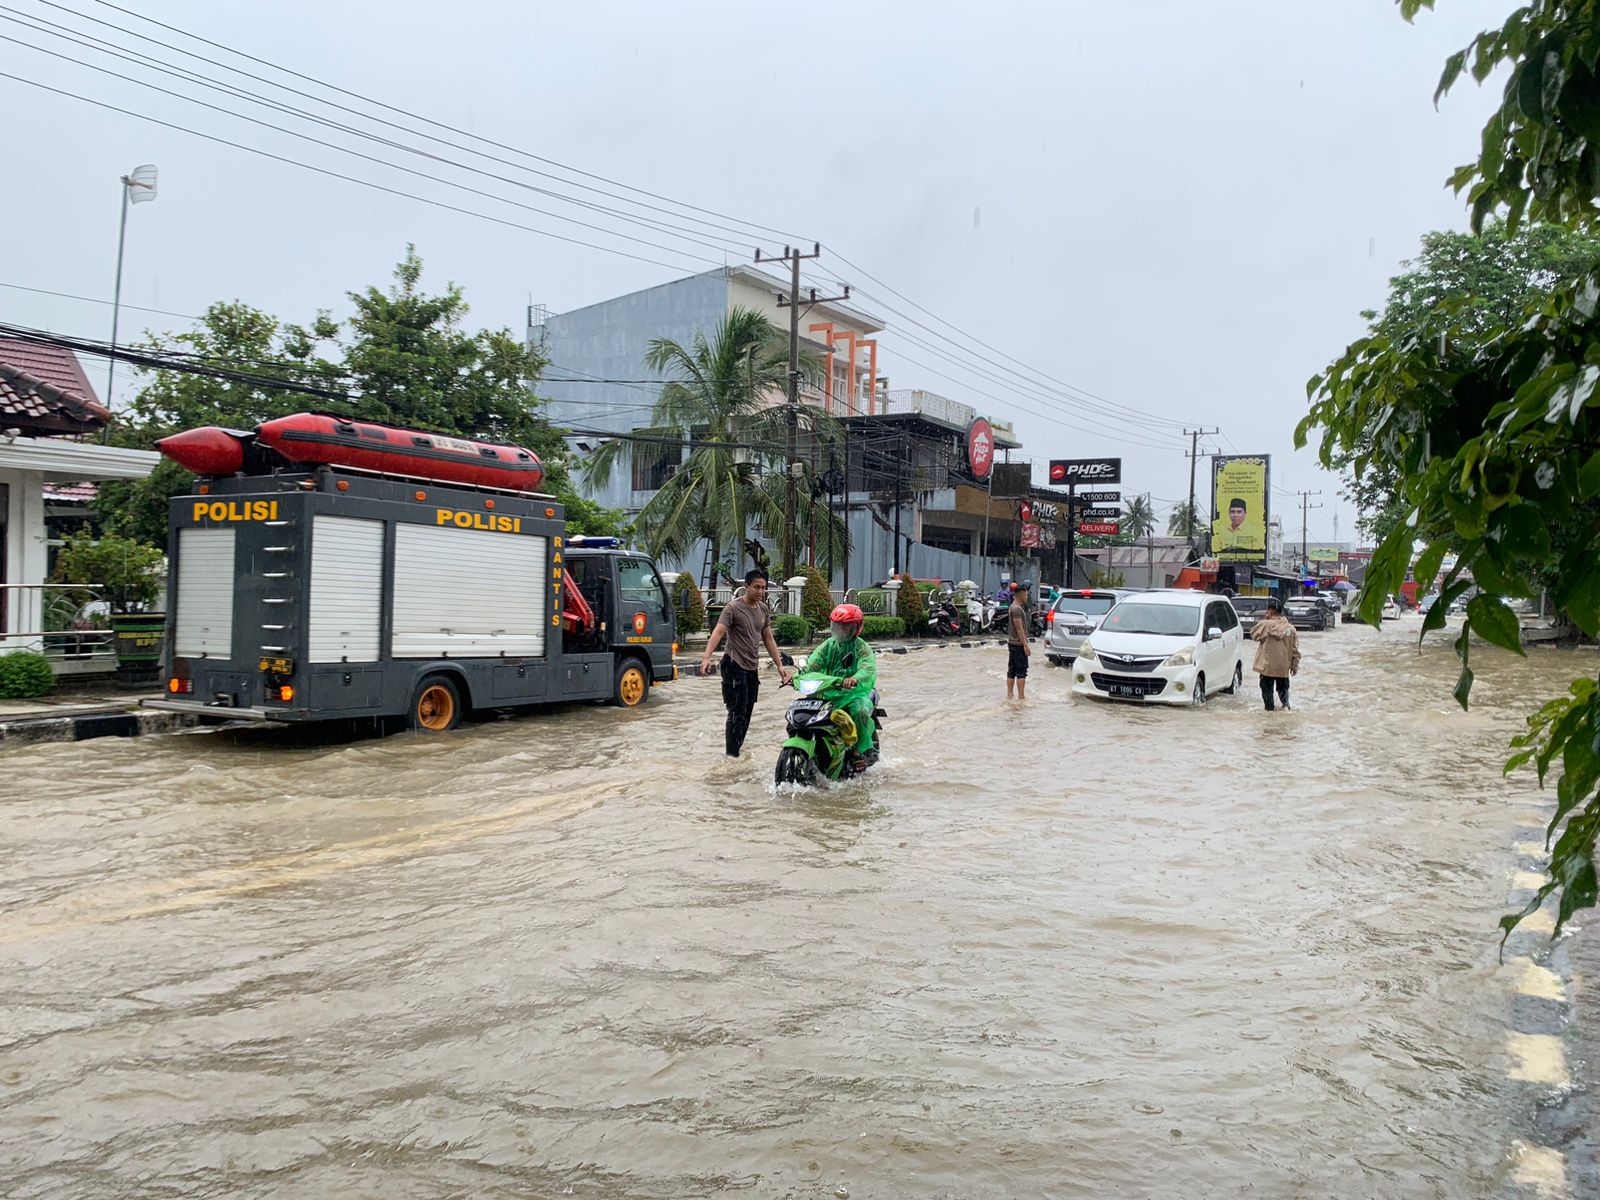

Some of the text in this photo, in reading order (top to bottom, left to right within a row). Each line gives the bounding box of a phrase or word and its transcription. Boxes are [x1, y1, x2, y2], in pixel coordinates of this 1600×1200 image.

[1067, 464, 1104, 475] PHD
[193, 501, 278, 521] POLISI
[1083, 509, 1115, 517] phd.co.id
[436, 509, 521, 533] POLISI
[1081, 524, 1116, 532] DELIVERY
[552, 536, 562, 626] RANTIS
